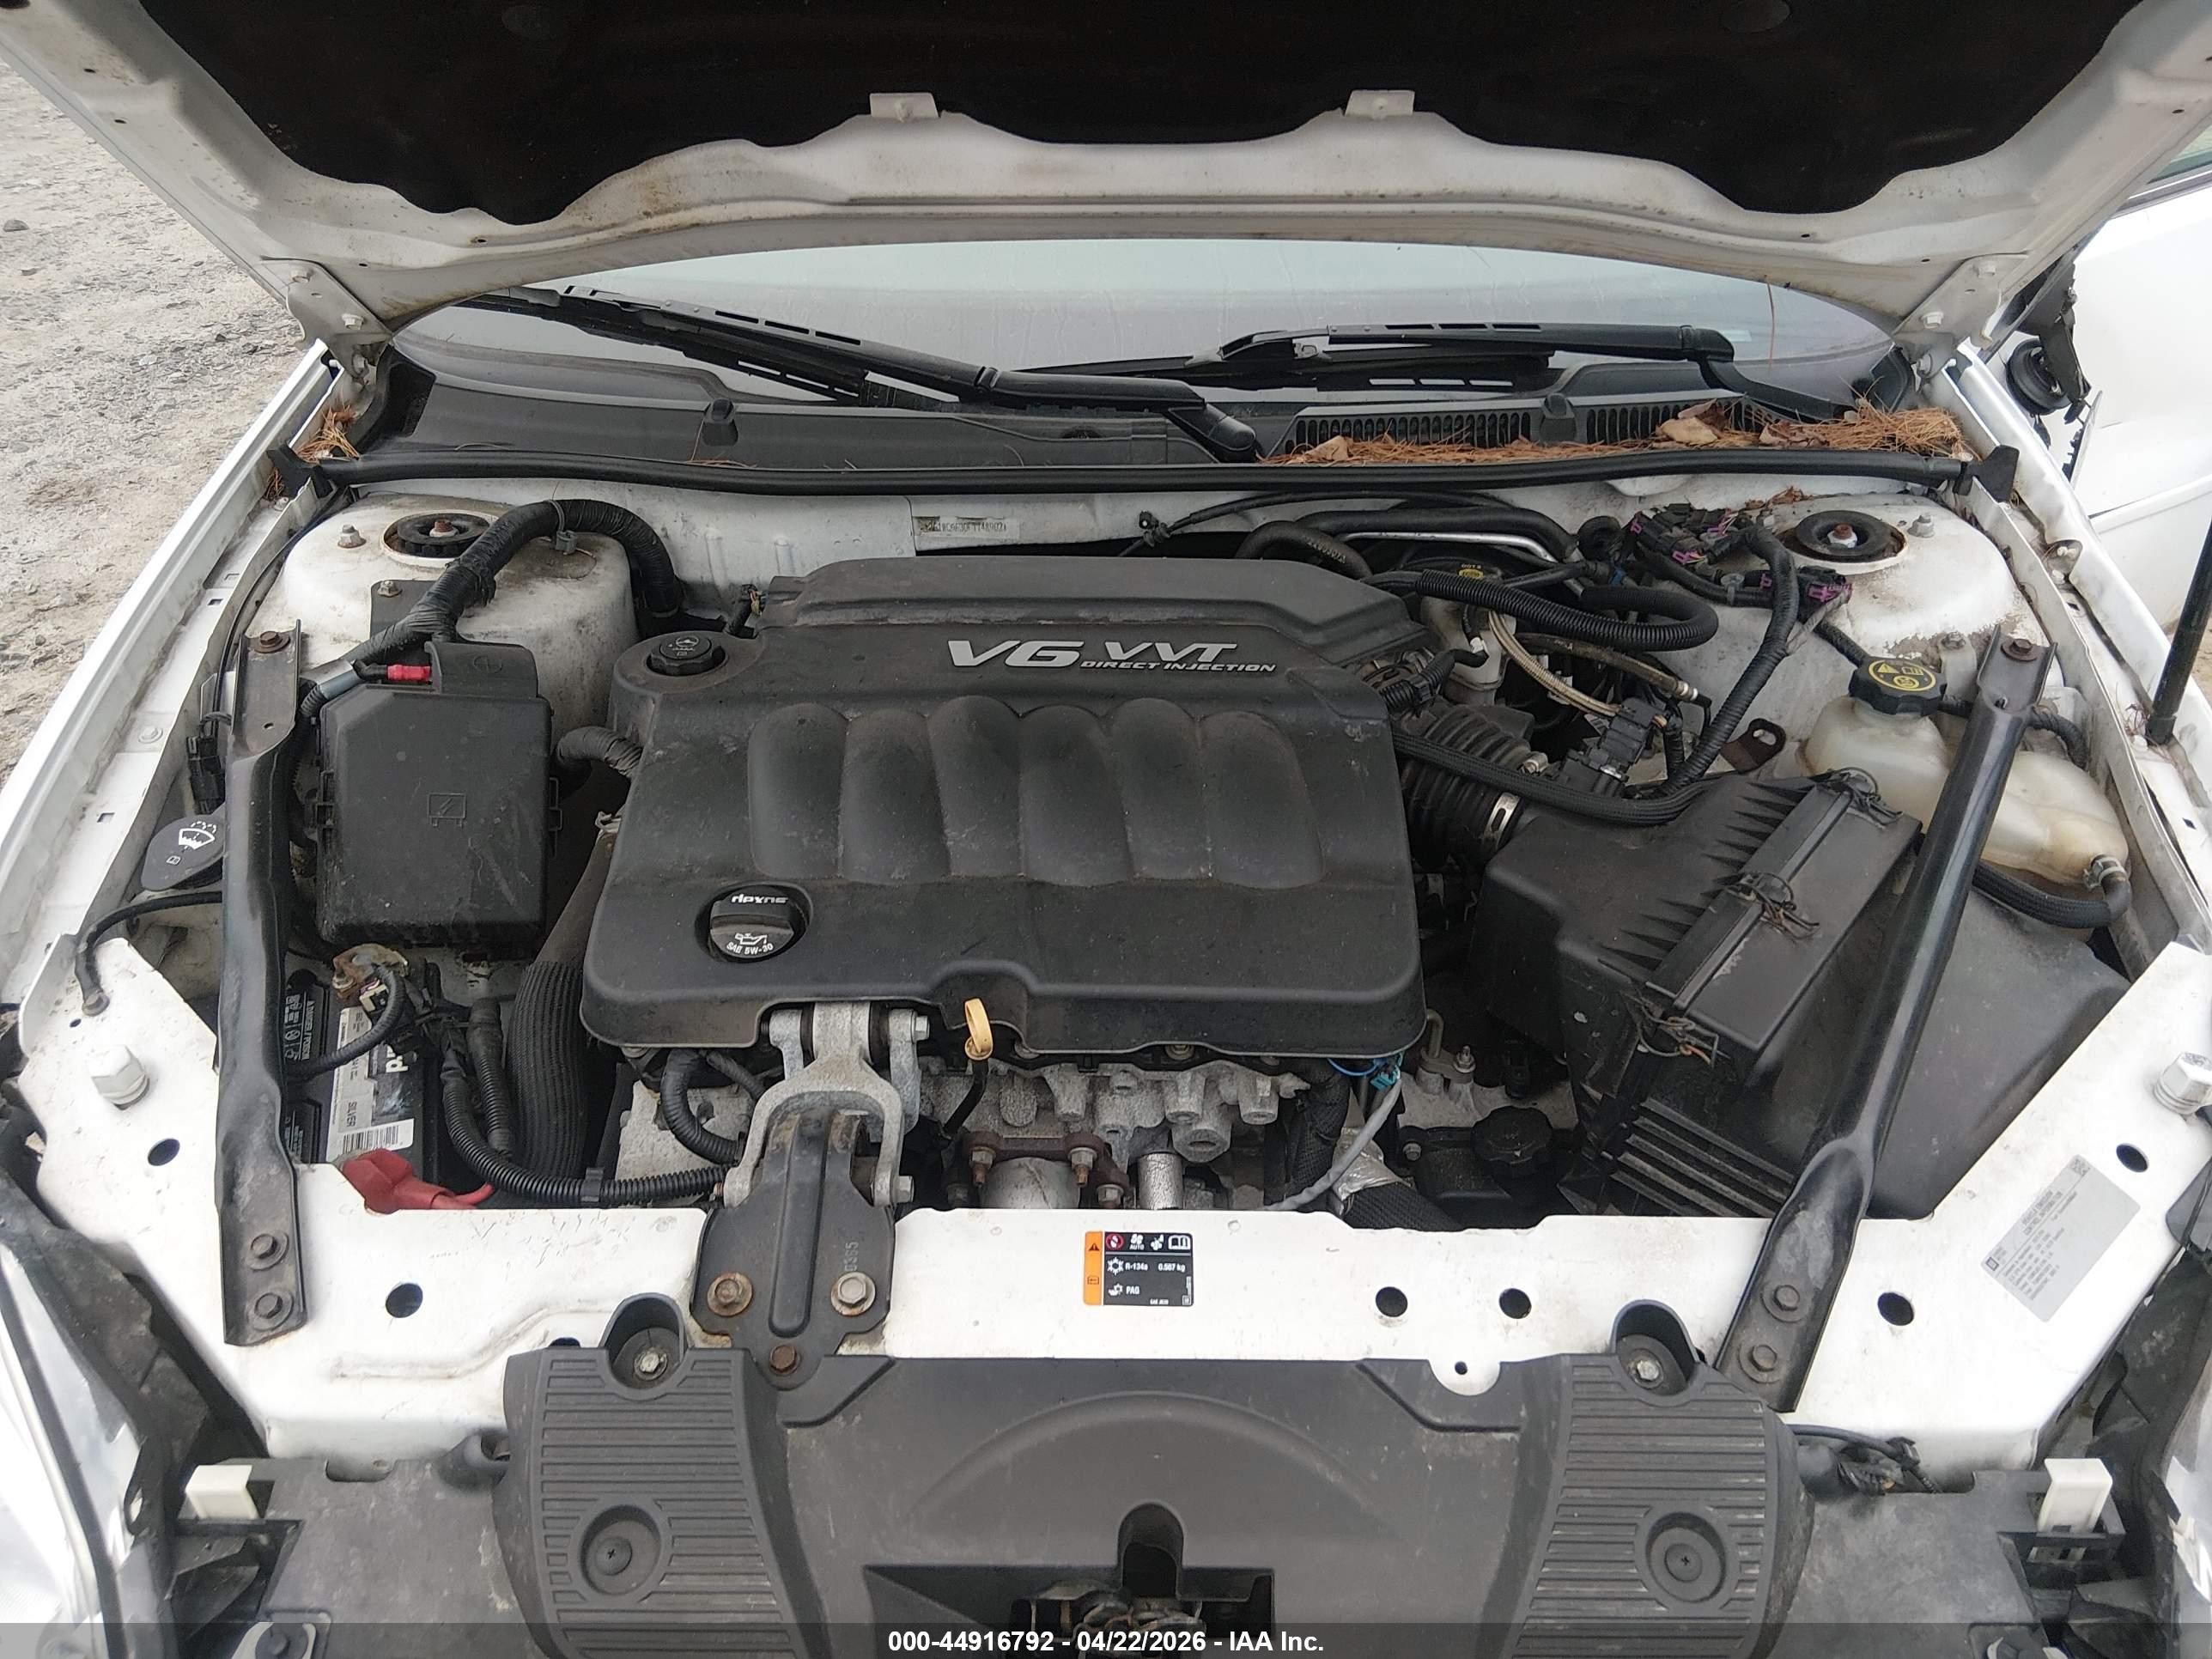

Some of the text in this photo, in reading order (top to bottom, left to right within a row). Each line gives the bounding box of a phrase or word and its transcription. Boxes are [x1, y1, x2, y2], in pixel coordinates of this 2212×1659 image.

[948, 640, 1237, 667] V6 VVT
[1080, 660, 1276, 672] DIRECT INJECTION
[726, 941, 774, 955] SAE 5W-30
[347, 1102, 356, 1127] SILVER
[1125, 1262, 1148, 1271] R-134a
[1176, 1263, 1186, 1273] kg
[1126, 1285, 1140, 1295] PAG
